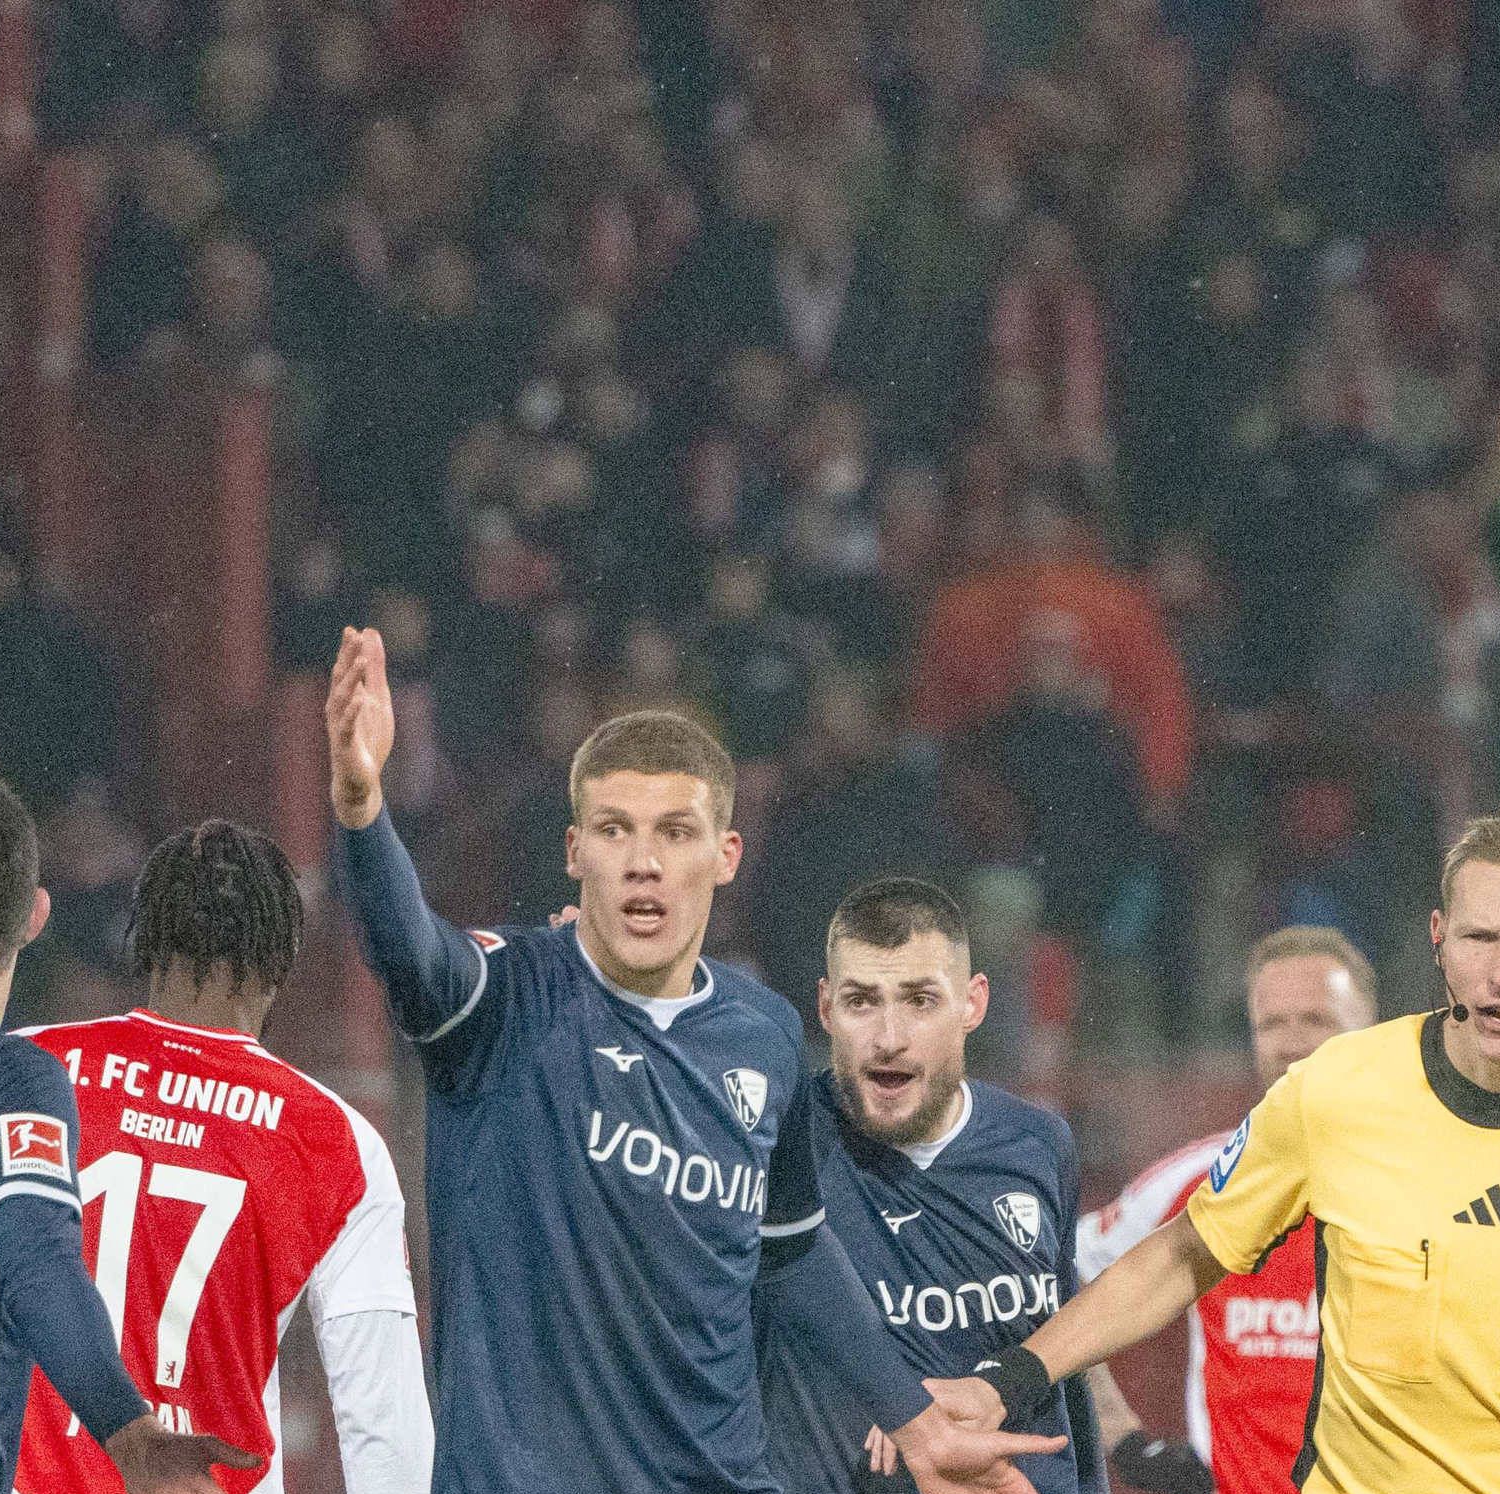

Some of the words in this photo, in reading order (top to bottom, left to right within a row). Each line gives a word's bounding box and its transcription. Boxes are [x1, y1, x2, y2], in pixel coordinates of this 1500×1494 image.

[65, 1048, 90, 1086] 1.
[100, 1053, 150, 1097] FC
[158, 1071, 285, 1130] UNION
[119, 1108, 205, 1148] BERLIN
[78, 1150, 248, 1388] 17
